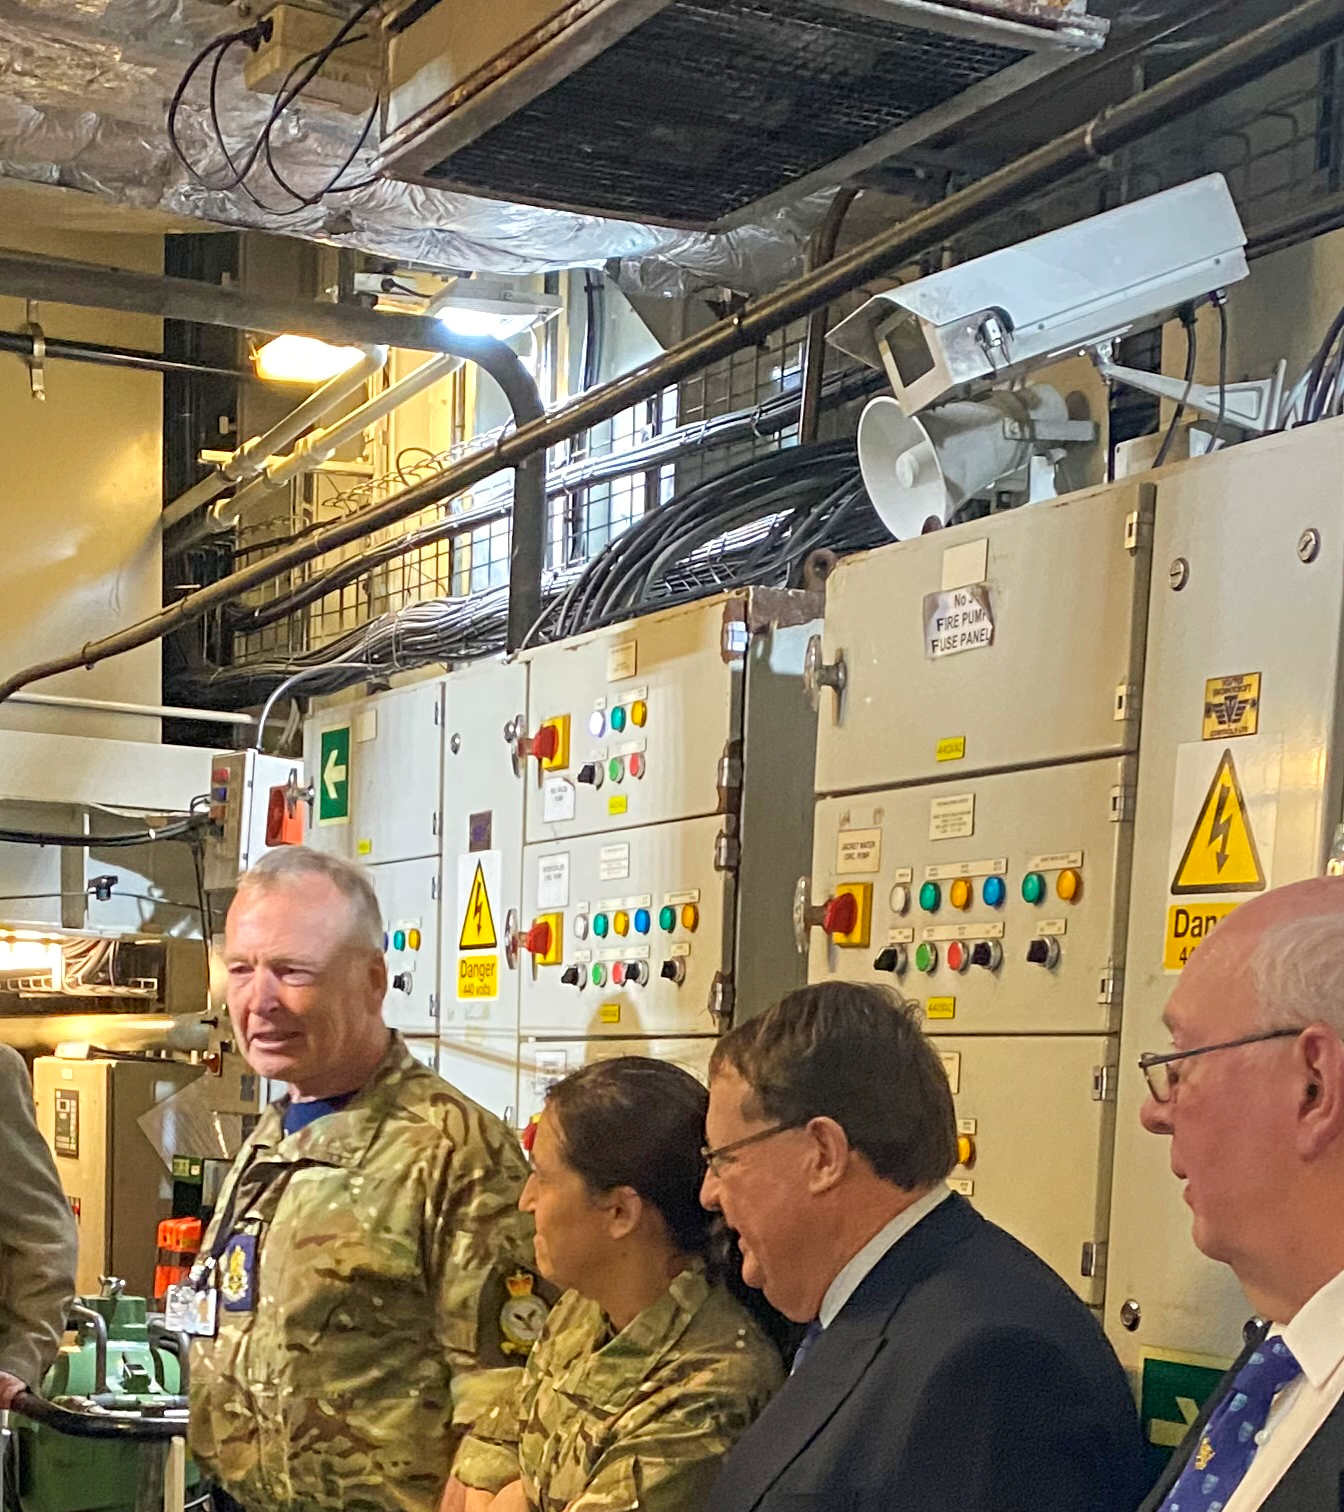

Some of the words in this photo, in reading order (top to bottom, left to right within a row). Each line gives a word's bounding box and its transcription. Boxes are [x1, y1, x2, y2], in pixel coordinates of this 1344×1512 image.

[954, 593, 966, 608] No
[936, 614, 960, 632] FIRE
[931, 635, 958, 653] FUSE
[960, 628, 990, 647] PANEL
[1174, 908, 1226, 938] Dan
[460, 960, 495, 983] Danger
